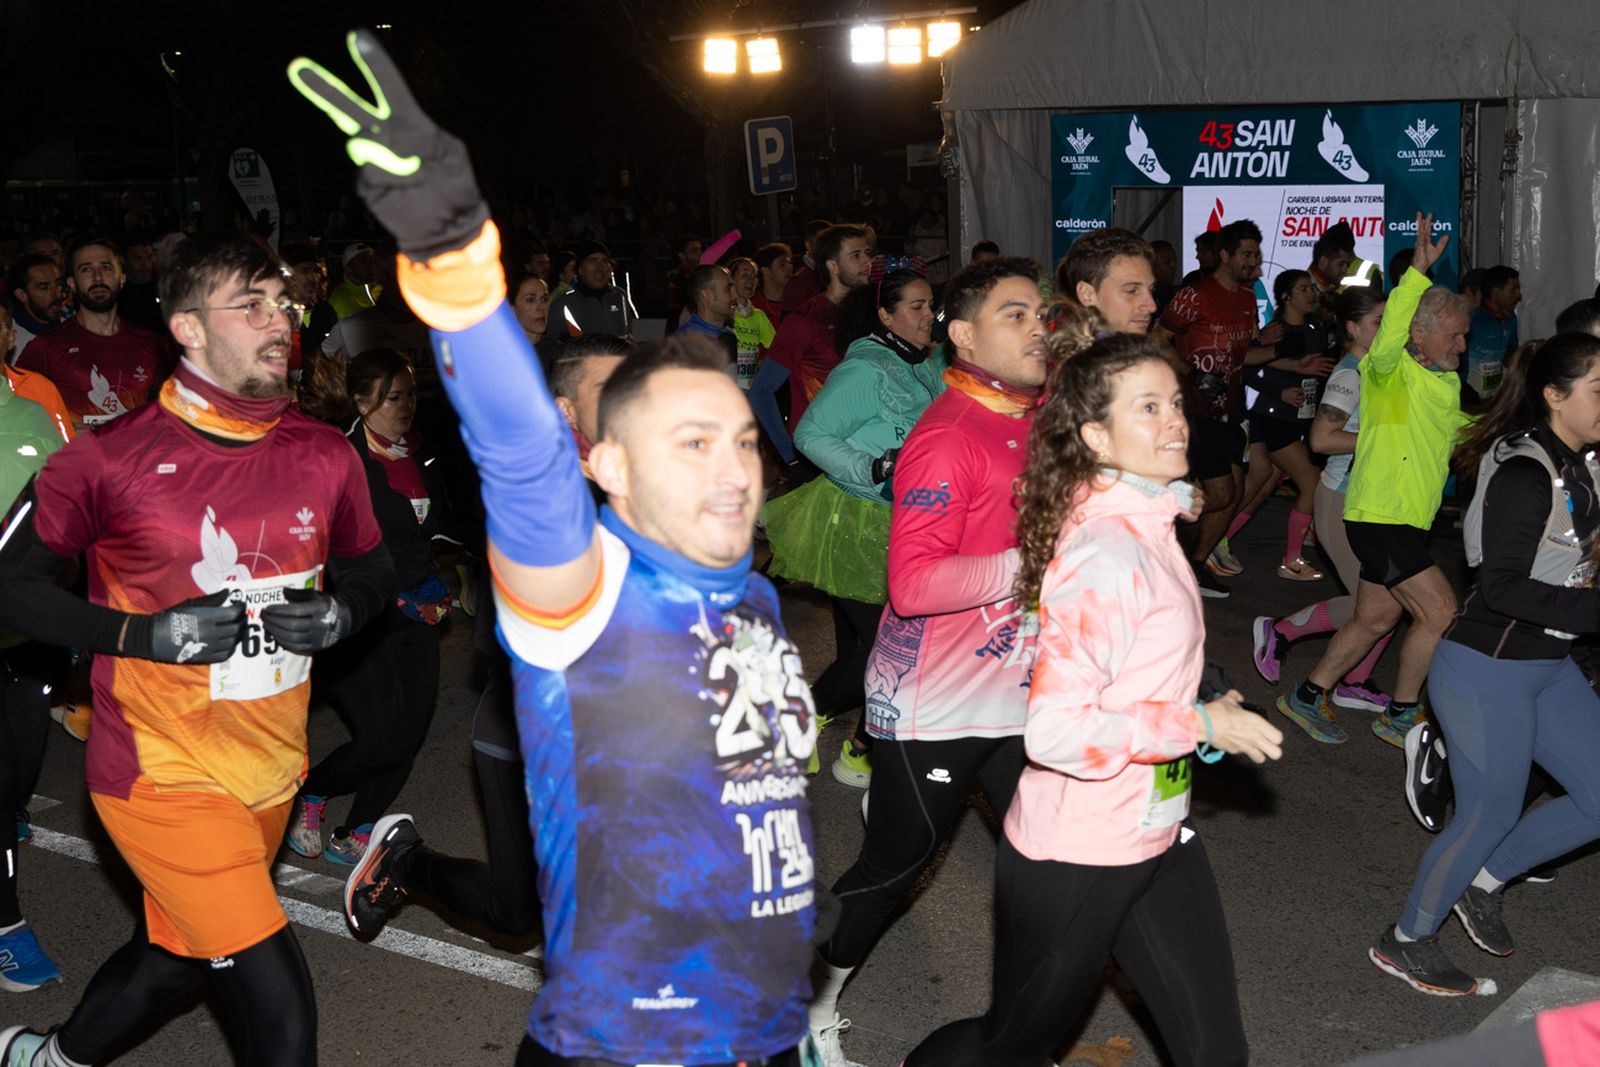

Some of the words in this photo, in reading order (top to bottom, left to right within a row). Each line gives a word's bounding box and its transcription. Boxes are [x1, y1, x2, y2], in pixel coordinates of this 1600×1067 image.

[1199, 120, 1234, 150] 43
[1234, 119, 1296, 147] SAN
[757, 127, 785, 184] P
[1190, 143, 1290, 178] ANTÓN
[1333, 151, 1352, 171] 43
[1397, 150, 1417, 158] CAJA
[1418, 150, 1446, 158] RURAL
[1138, 153, 1156, 173] 43
[1287, 196, 1320, 204] CARRERA
[1321, 196, 1351, 204] URBANA
[1286, 206, 1317, 216] NOCHE
[1319, 206, 1331, 215] DE
[1055, 218, 1106, 229] calderón
[1388, 220, 1452, 231] caldón
[103, 396, 118, 412] 43
[245, 590, 281, 604] NOCHE
[751, 899, 775, 918] LA
